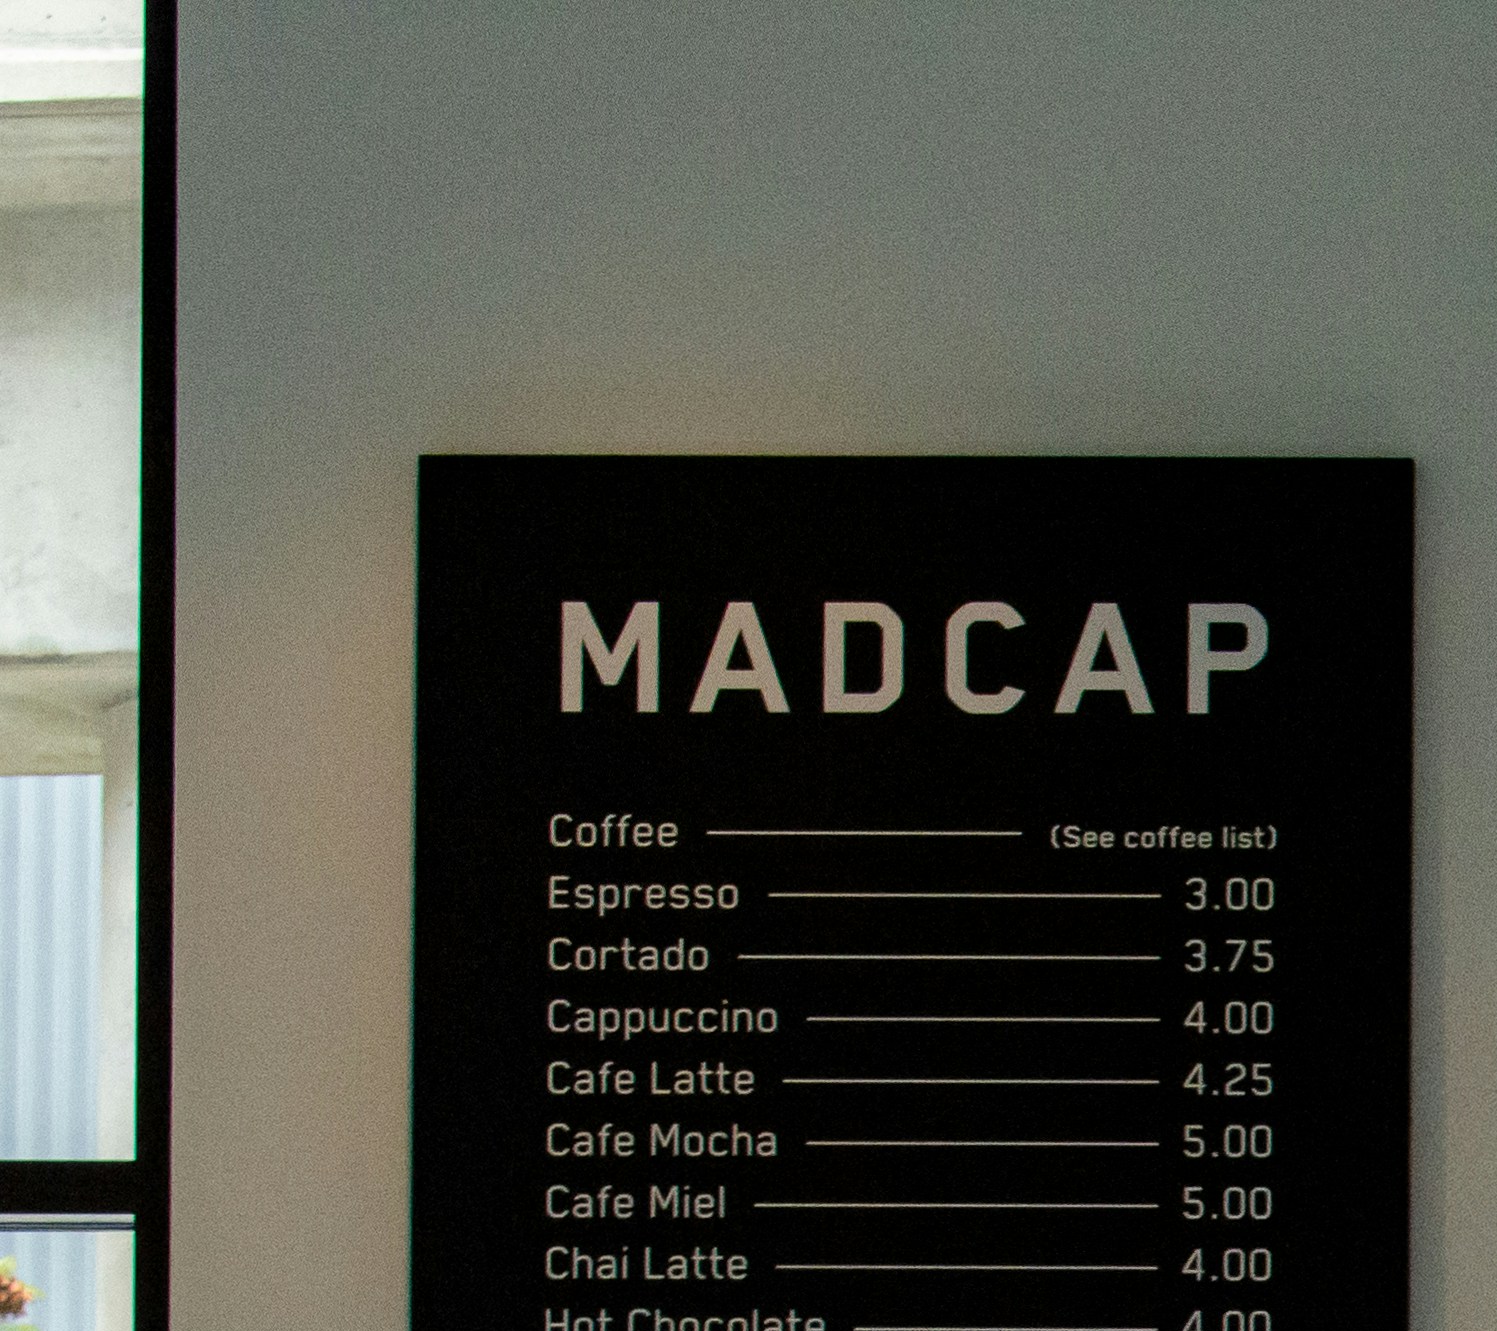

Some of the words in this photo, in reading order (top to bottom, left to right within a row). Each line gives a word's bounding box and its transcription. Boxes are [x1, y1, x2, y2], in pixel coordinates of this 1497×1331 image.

[560, 600, 1269, 715] MADCAP
[548, 812, 679, 848] Coffee
[1050, 824, 1116, 849] (See
[1123, 825, 1213, 850] coffee
[1221, 825, 1278, 850] list)
[548, 874, 740, 918] Espresso
[1185, 876, 1275, 912] 3.00
[547, 936, 710, 972] Cortado
[1184, 938, 1275, 974] 3.75
[546, 998, 779, 1041] Cappuccino
[1183, 1000, 1274, 1035] 4.00
[546, 1060, 636, 1096] Cafe
[650, 1061, 755, 1096] Latte
[1182, 1062, 1274, 1097] 4.25
[545, 1121, 635, 1158] Cafe
[649, 1122, 778, 1158] Mocha
[1183, 1123, 1273, 1159] 5.00
[545, 1183, 635, 1220] Cafe
[649, 1184, 726, 1220] Miel
[1182, 1185, 1273, 1221] 5.00
[545, 1244, 629, 1281] Chai
[643, 1246, 749, 1281] Latte
[1181, 1247, 1273, 1283] 4.00
